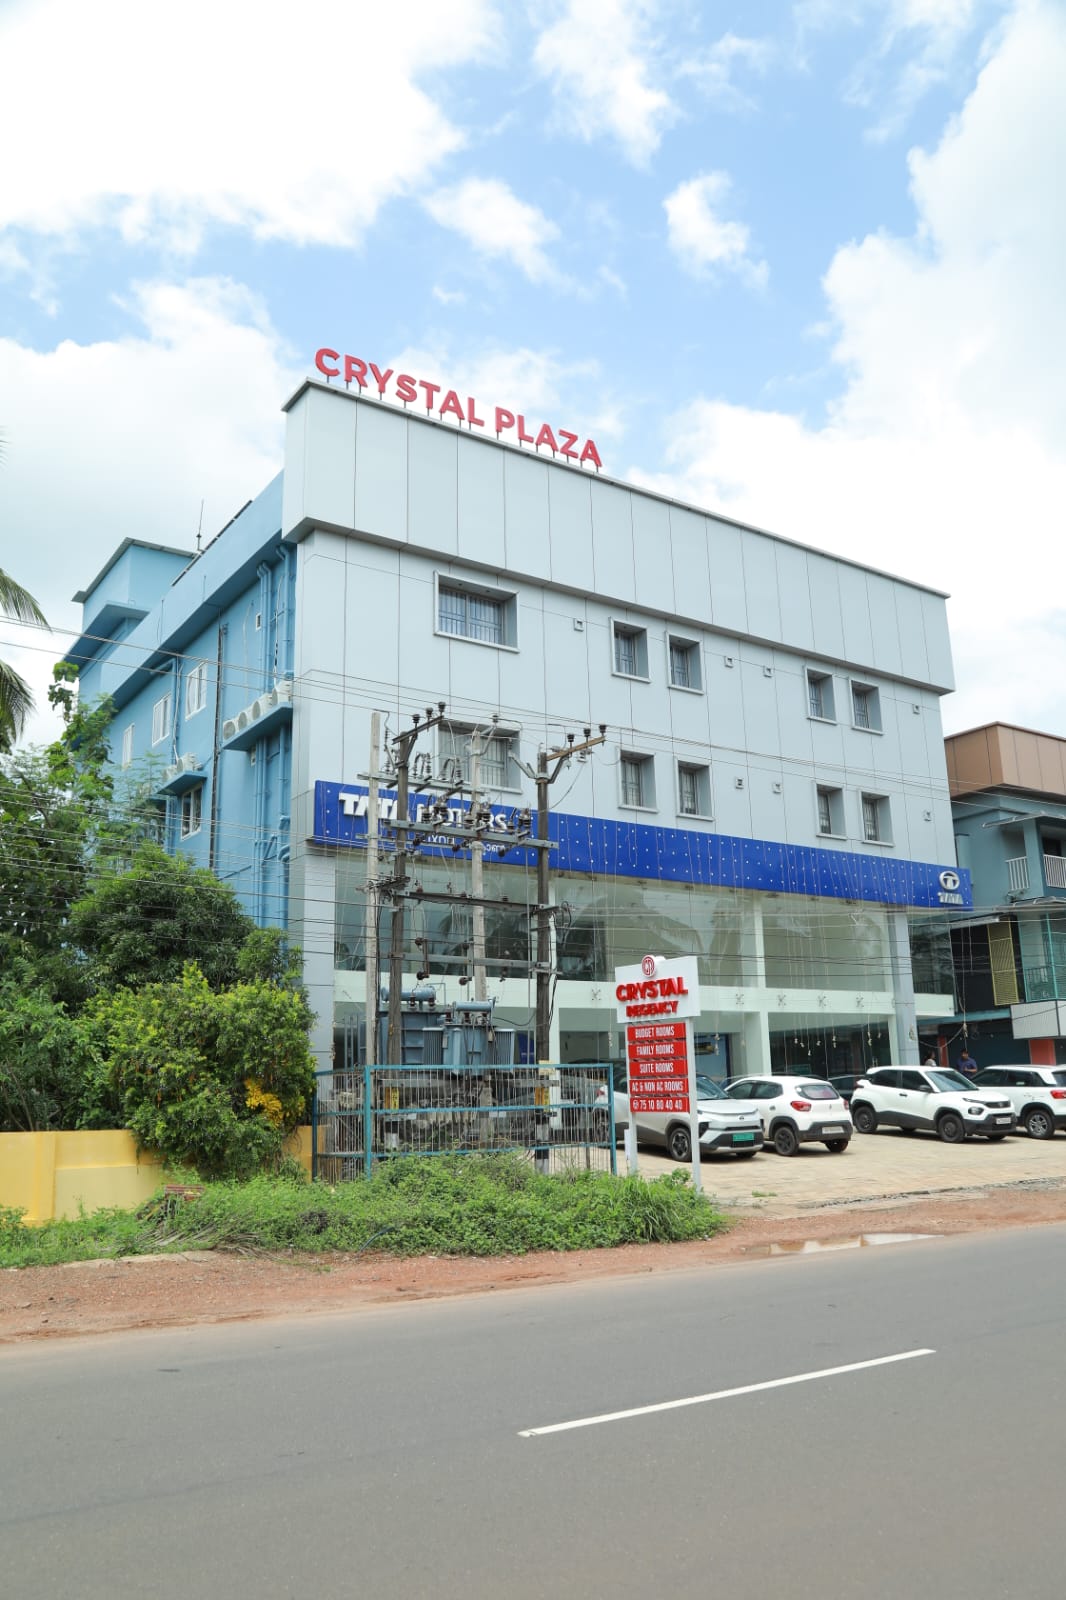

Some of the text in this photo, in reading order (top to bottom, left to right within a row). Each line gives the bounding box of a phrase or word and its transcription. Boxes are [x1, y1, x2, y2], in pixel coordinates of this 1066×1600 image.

[314, 348, 603, 467] CRYSTAL PLAZA
[616, 976, 689, 1002] CRYSTAL
[626, 1001, 679, 1018] REGENCY
[635, 1025, 675, 1039] BUDGET ROOMS
[636, 1043, 675, 1056] FAMILY ROOMS
[639, 1062, 674, 1074] SUITE ROOMS
[632, 1082, 639, 1092] AC
[644, 1081, 655, 1092] NON
[656, 1081, 664, 1091] AC
[664, 1081, 684, 1092] ROOMS
[640, 1099, 647, 1110] 75
[648, 1099, 655, 1110] 10
[665, 1099, 673, 1110] 40
[674, 1099, 683, 1110] 40
